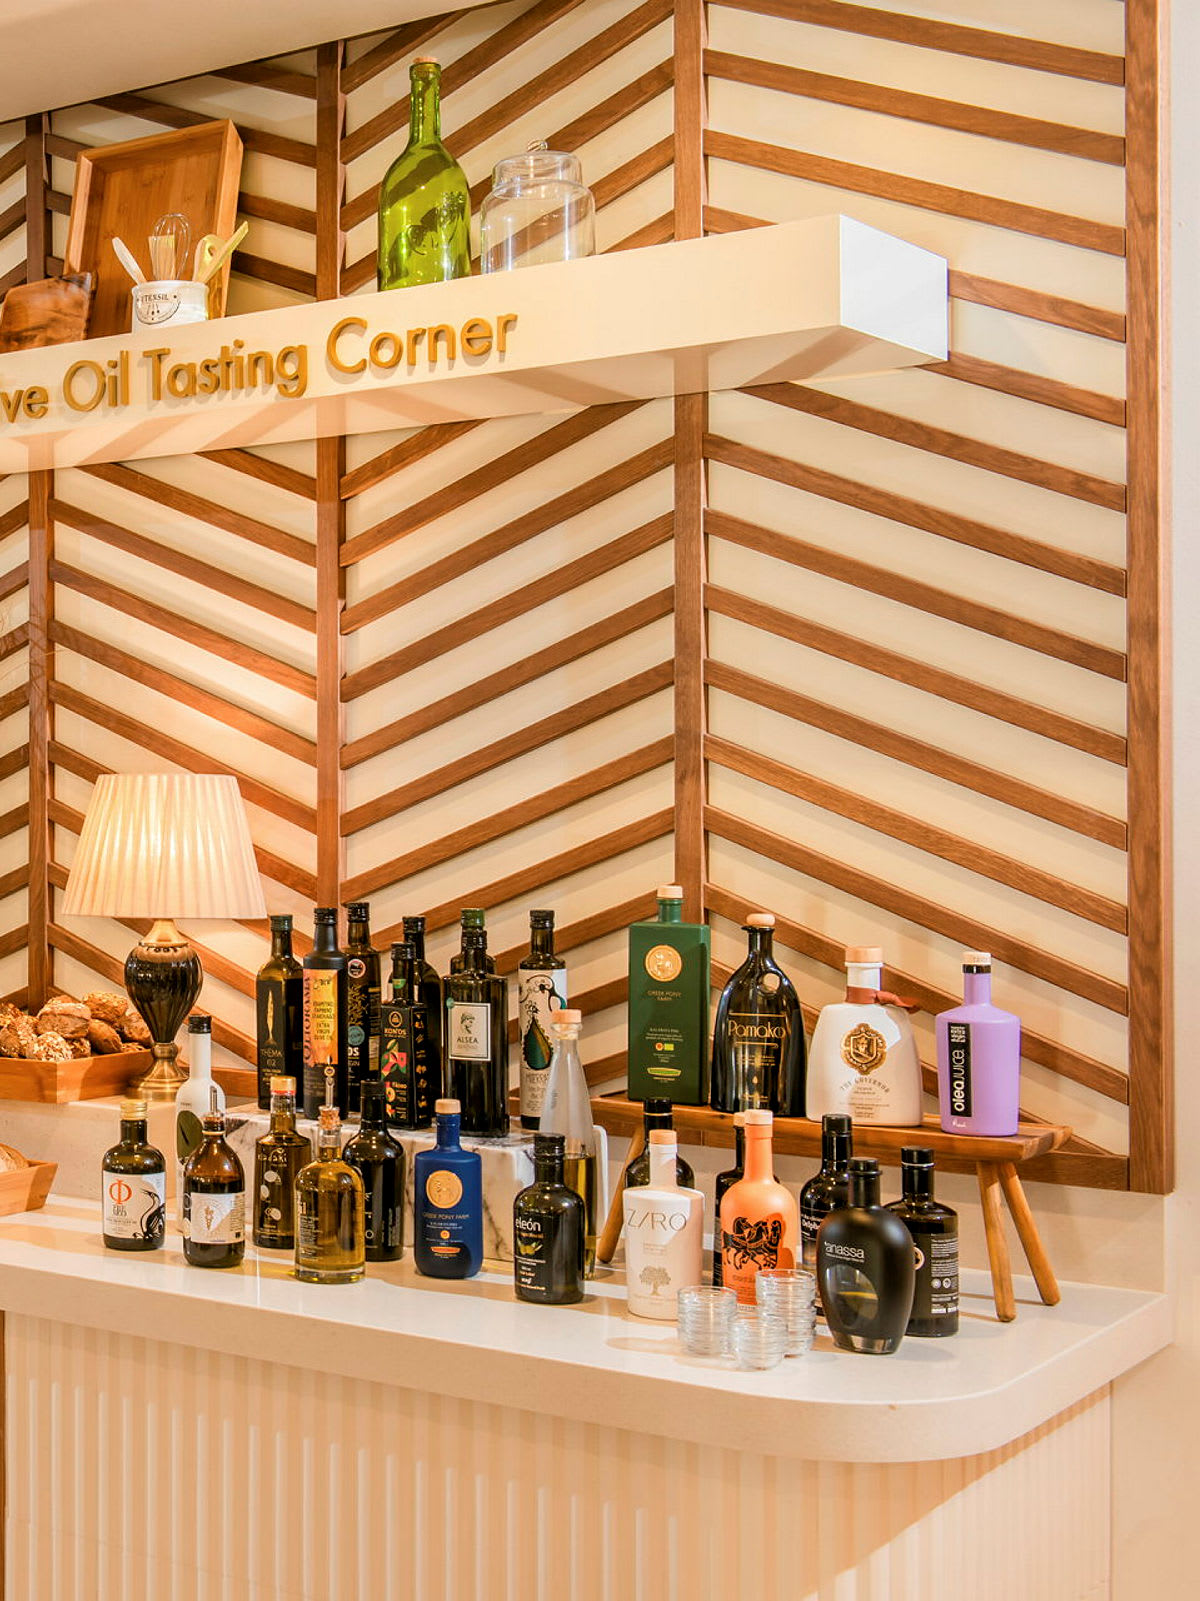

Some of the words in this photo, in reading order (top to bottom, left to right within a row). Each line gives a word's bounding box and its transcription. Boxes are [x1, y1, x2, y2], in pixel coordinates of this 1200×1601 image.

[62, 351, 130, 412] Oil
[142, 338, 309, 398] Tasting
[326, 313, 519, 374] Corner
